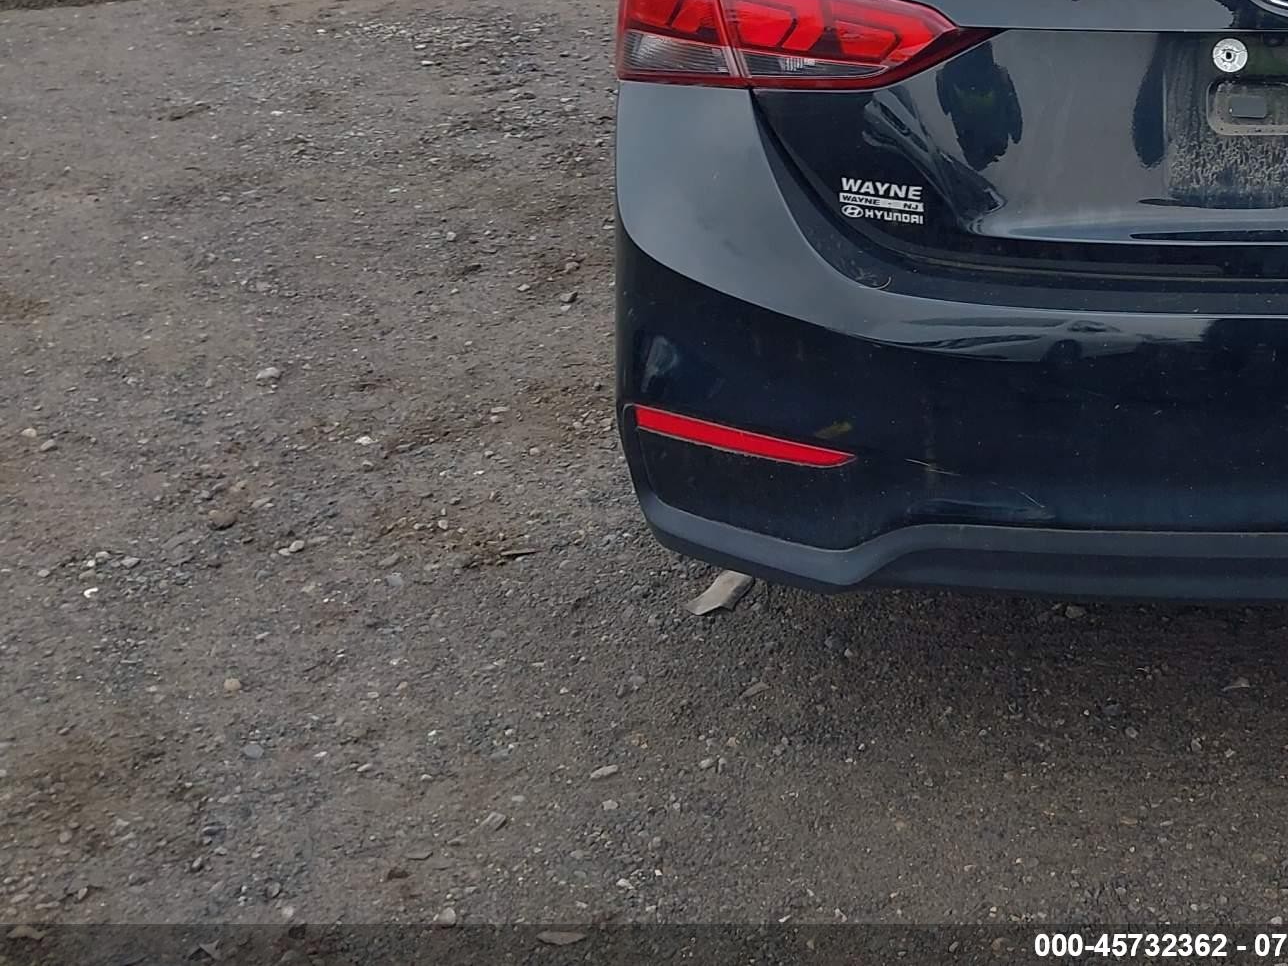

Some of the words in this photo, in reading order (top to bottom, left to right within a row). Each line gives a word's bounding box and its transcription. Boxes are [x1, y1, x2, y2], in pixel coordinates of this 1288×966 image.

[841, 177, 922, 200] WAYNE
[842, 195, 880, 205] WAYNE
[865, 208, 924, 224] HYUNDAI
